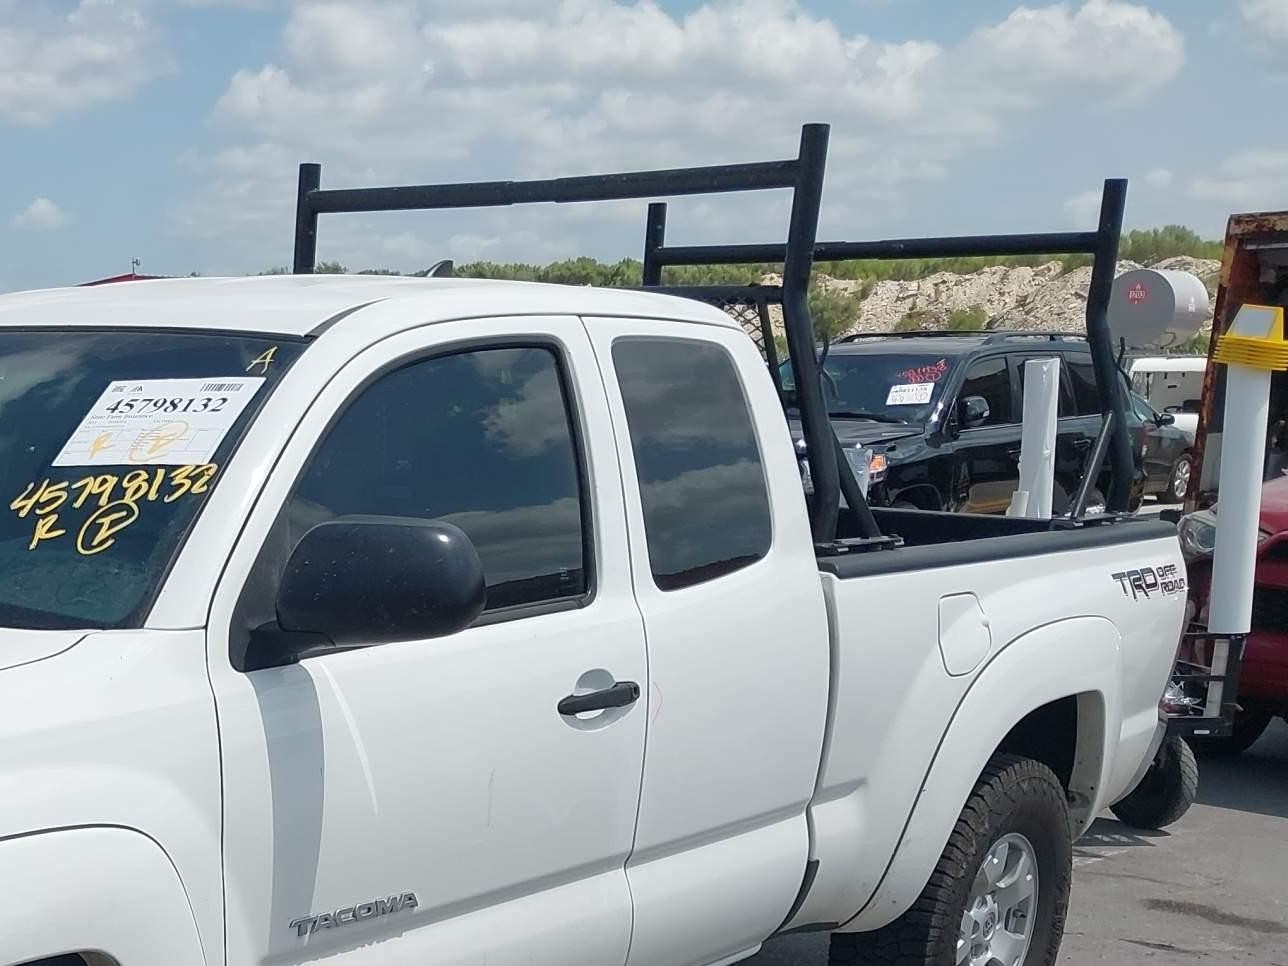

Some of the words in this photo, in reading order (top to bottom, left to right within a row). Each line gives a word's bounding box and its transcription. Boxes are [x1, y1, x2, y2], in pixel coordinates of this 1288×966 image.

[246, 346, 278, 375] A
[106, 397, 229, 414] 45798132
[9, 463, 218, 517] 45798132
[1111, 566, 1159, 602] TRD
[1156, 563, 1178, 579] OFF
[1160, 578, 1187, 596] ROAD
[289, 892, 419, 937] TACOMA
